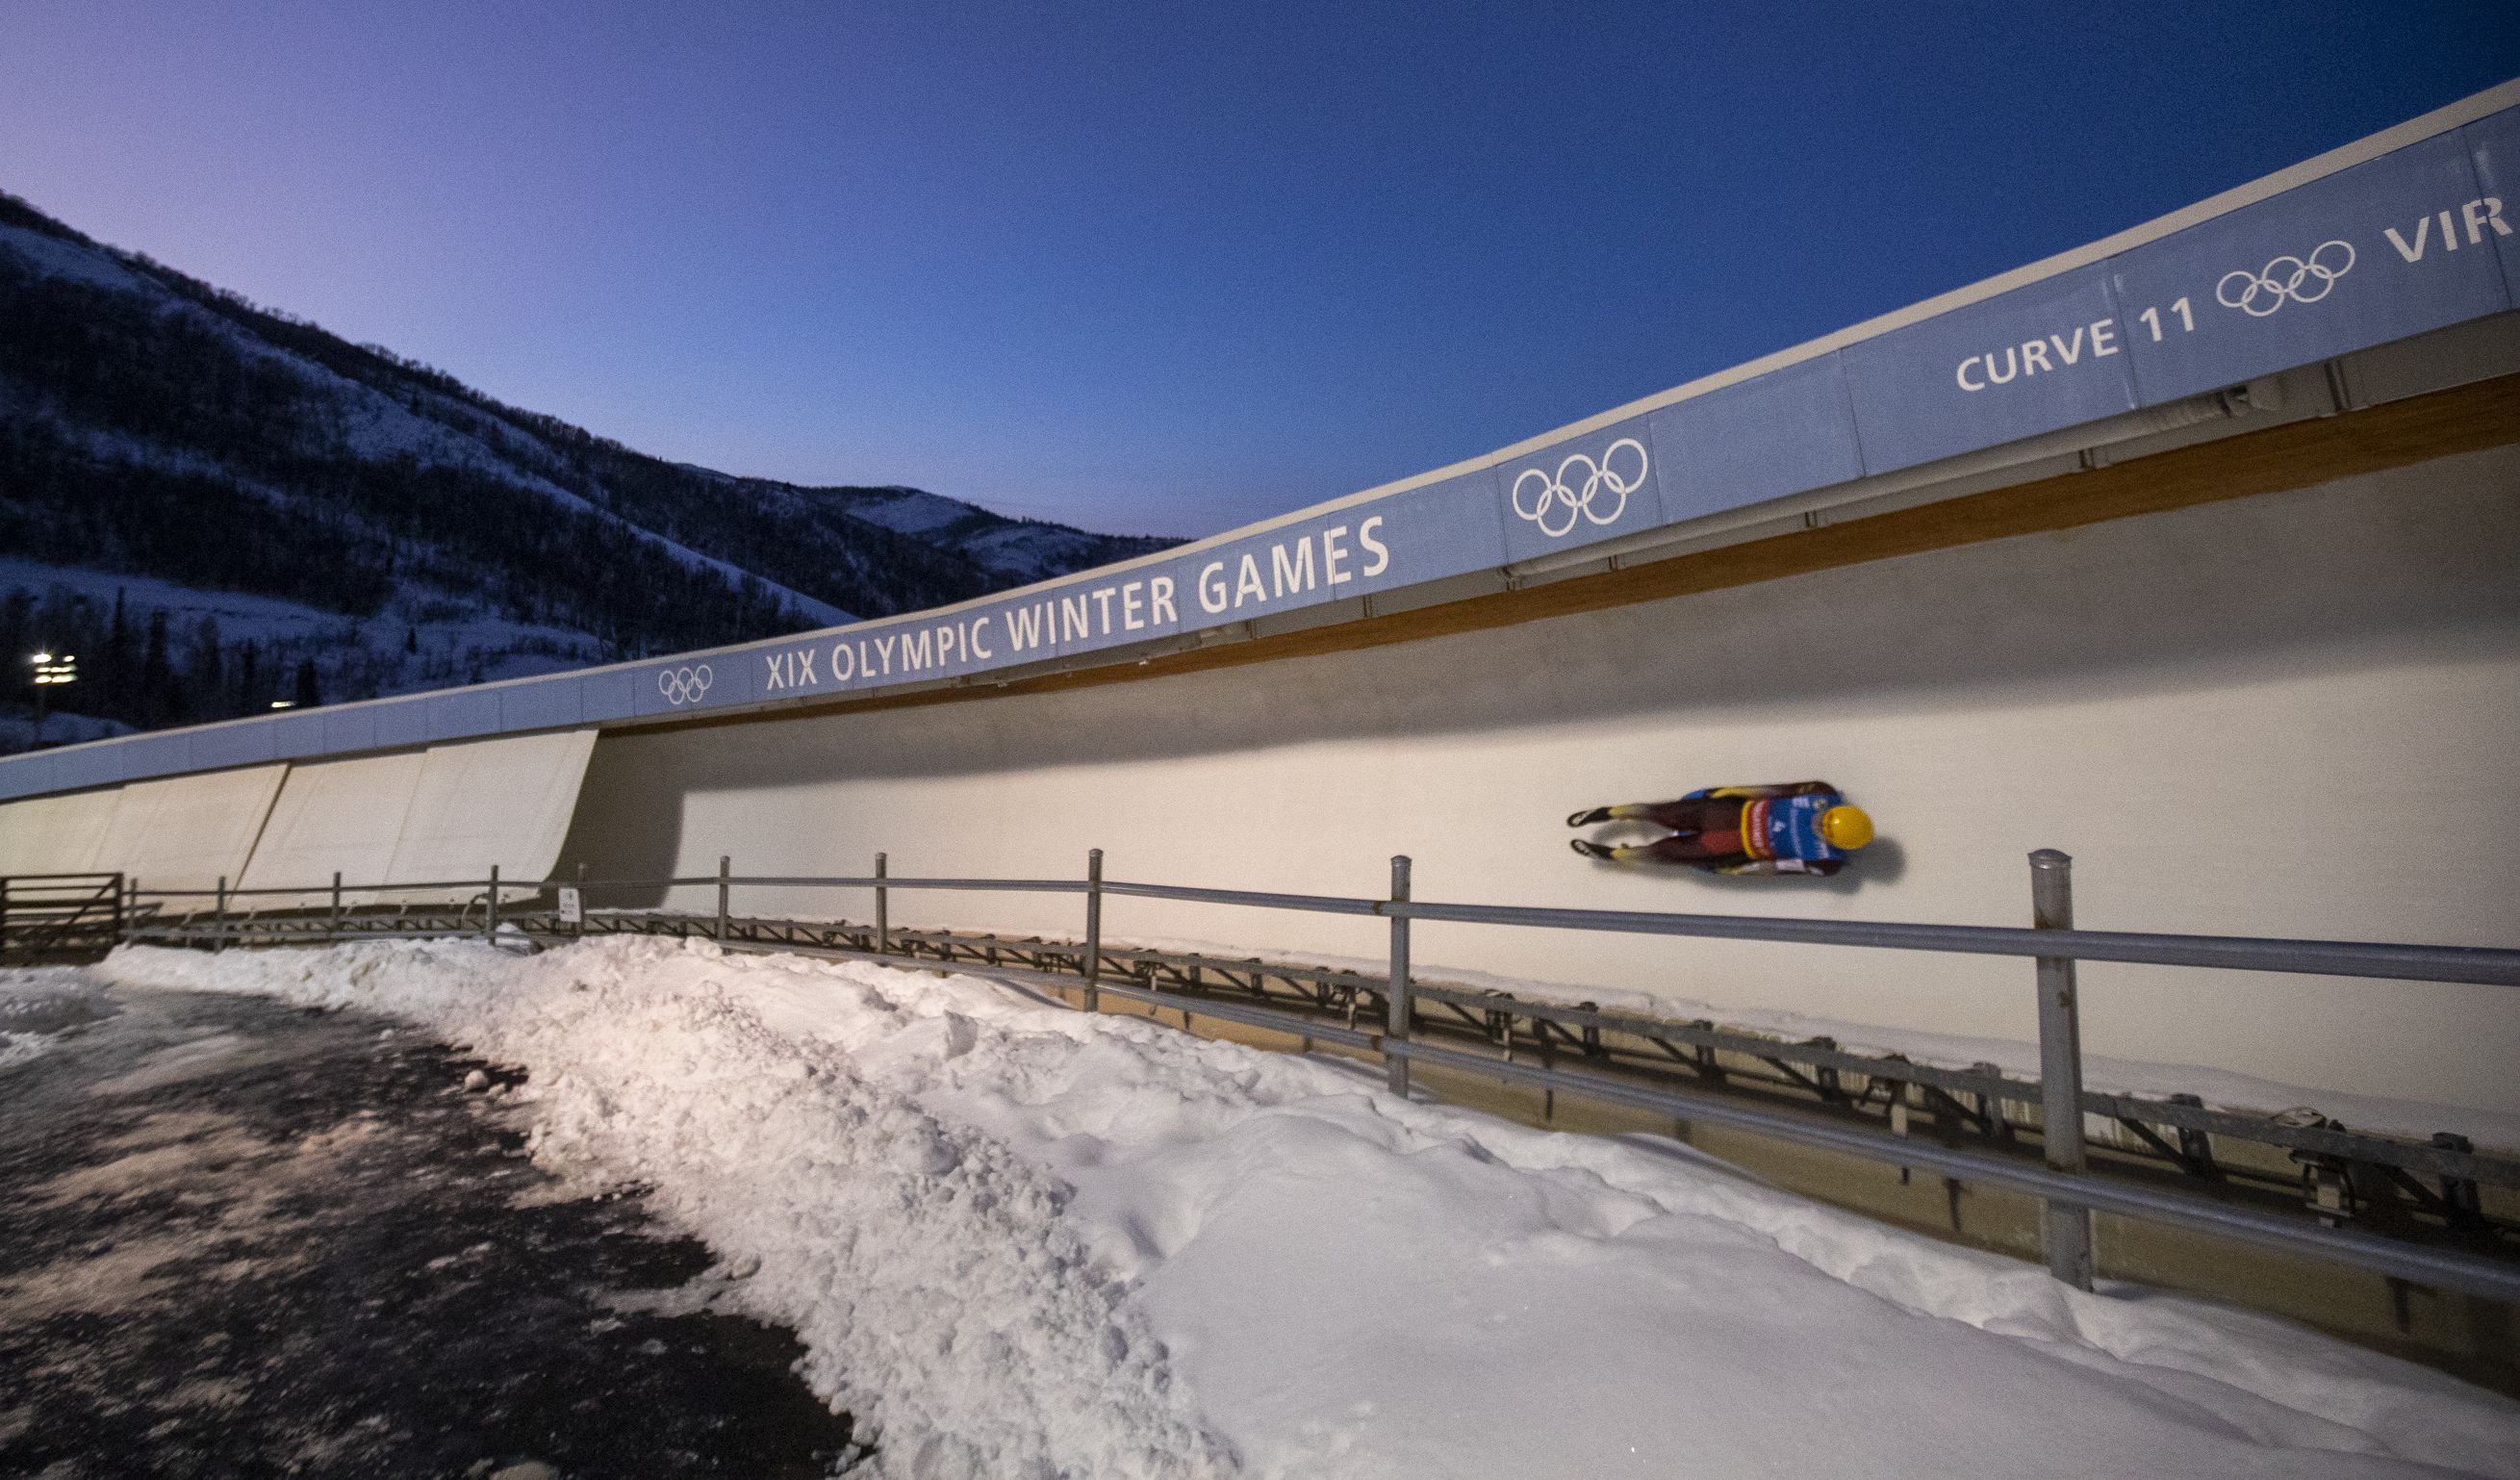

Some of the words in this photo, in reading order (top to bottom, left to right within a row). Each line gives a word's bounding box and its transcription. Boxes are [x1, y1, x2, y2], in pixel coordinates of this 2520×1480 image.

[2383, 196, 2513, 264] VIR
[1955, 319, 2119, 392] CURVE
[2139, 296, 2195, 343] 11
[766, 649, 818, 690] XIX
[831, 617, 992, 681] OLYMPIC
[1005, 576, 1179, 651] WINTER
[1198, 515, 1389, 614] GAMES
